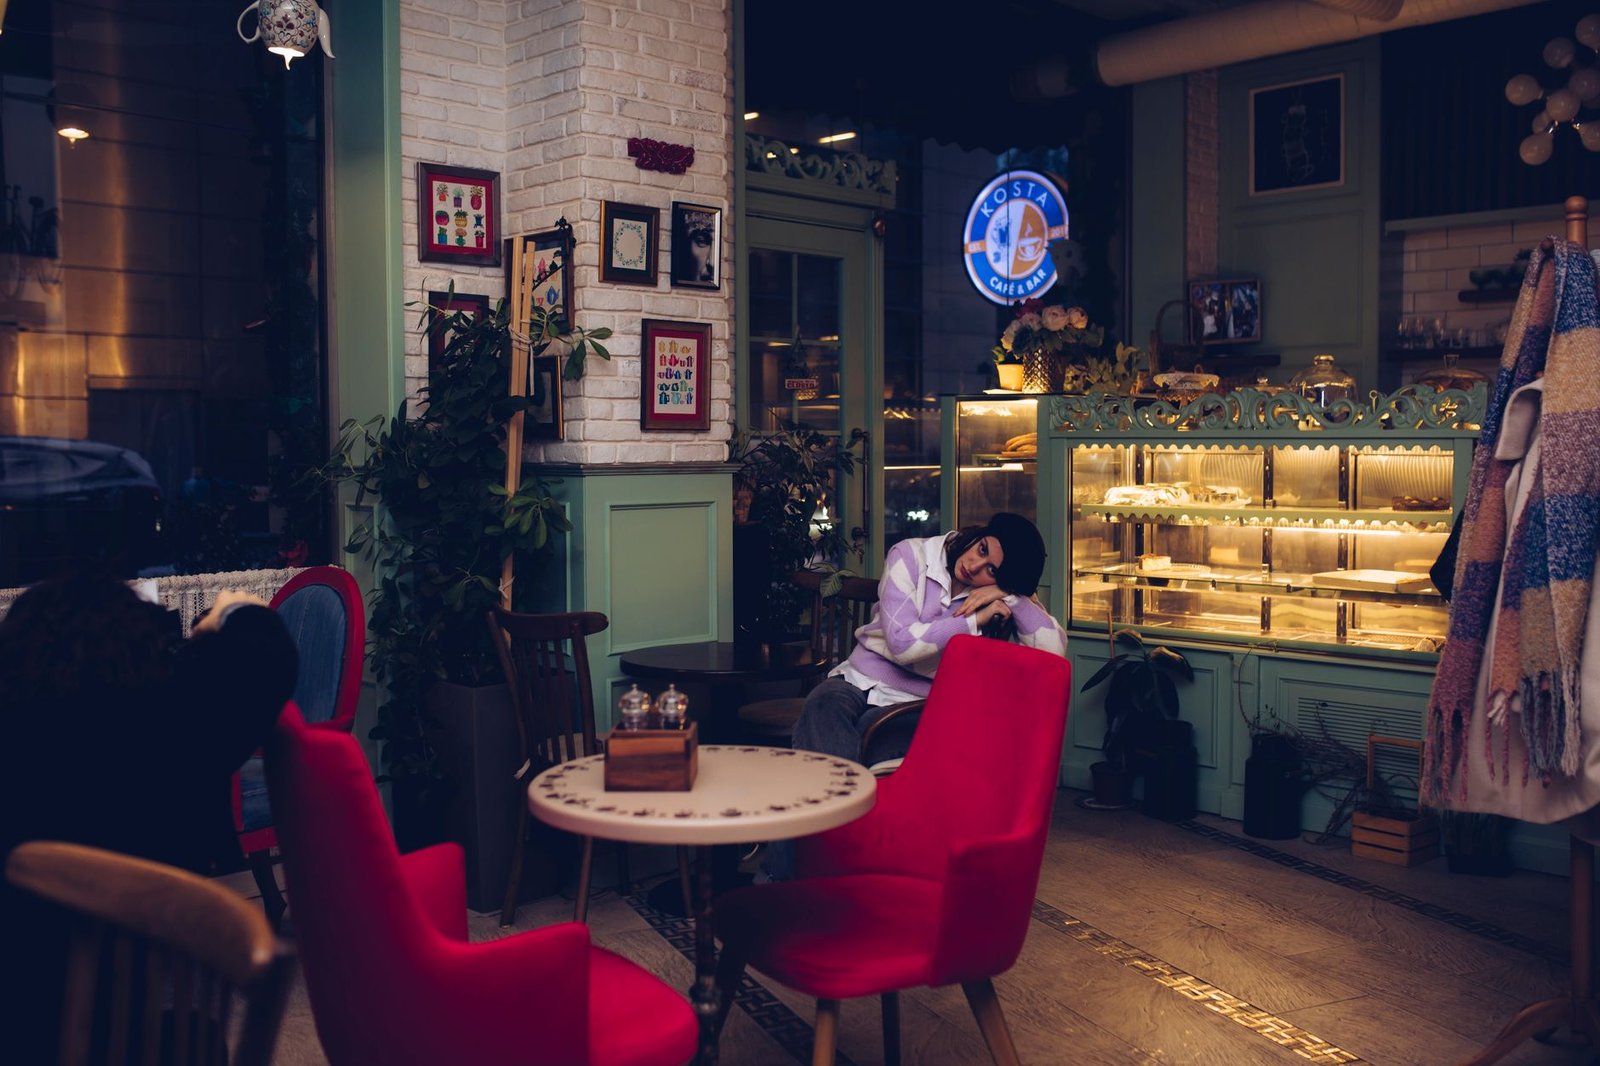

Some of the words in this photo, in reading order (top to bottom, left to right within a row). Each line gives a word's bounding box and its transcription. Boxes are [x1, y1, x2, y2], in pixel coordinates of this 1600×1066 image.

[981, 181, 1048, 218] KOSTA
[989, 276, 1015, 295] CAFÉ
[1017, 284, 1025, 295] &
[1026, 268, 1047, 291] BAR
